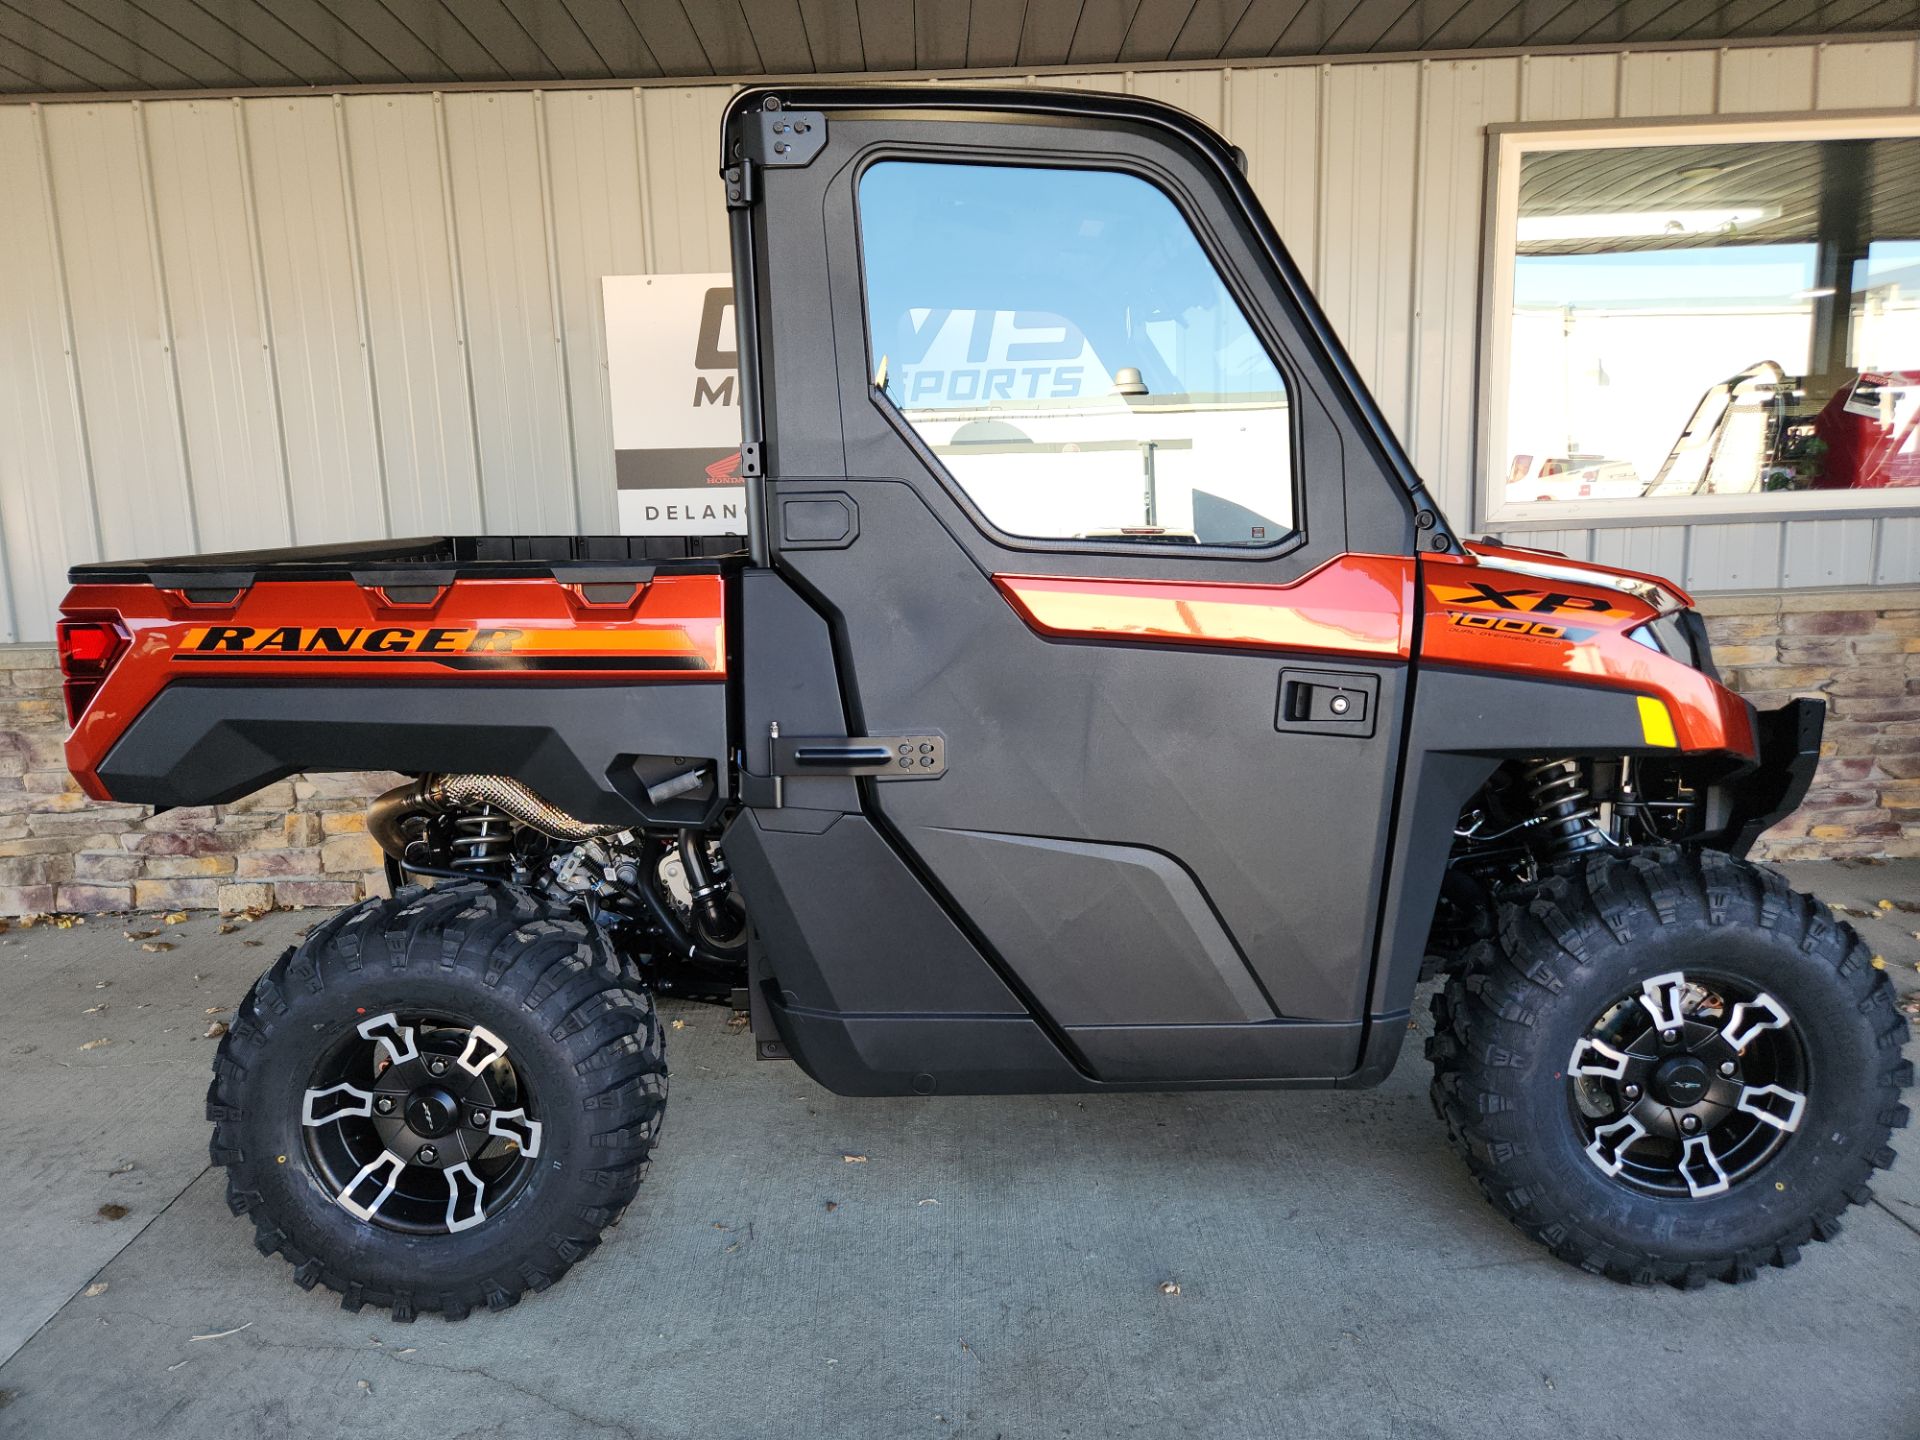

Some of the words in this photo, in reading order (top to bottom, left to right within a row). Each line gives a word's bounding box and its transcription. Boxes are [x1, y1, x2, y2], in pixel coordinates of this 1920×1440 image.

[901, 366, 1084, 401] PORTS
[706, 476, 745, 484] HONDA
[645, 504, 747, 521] DELAN
[1444, 581, 1613, 614] XP
[1448, 611, 1568, 639] 1000
[195, 626, 523, 653] RANGER
